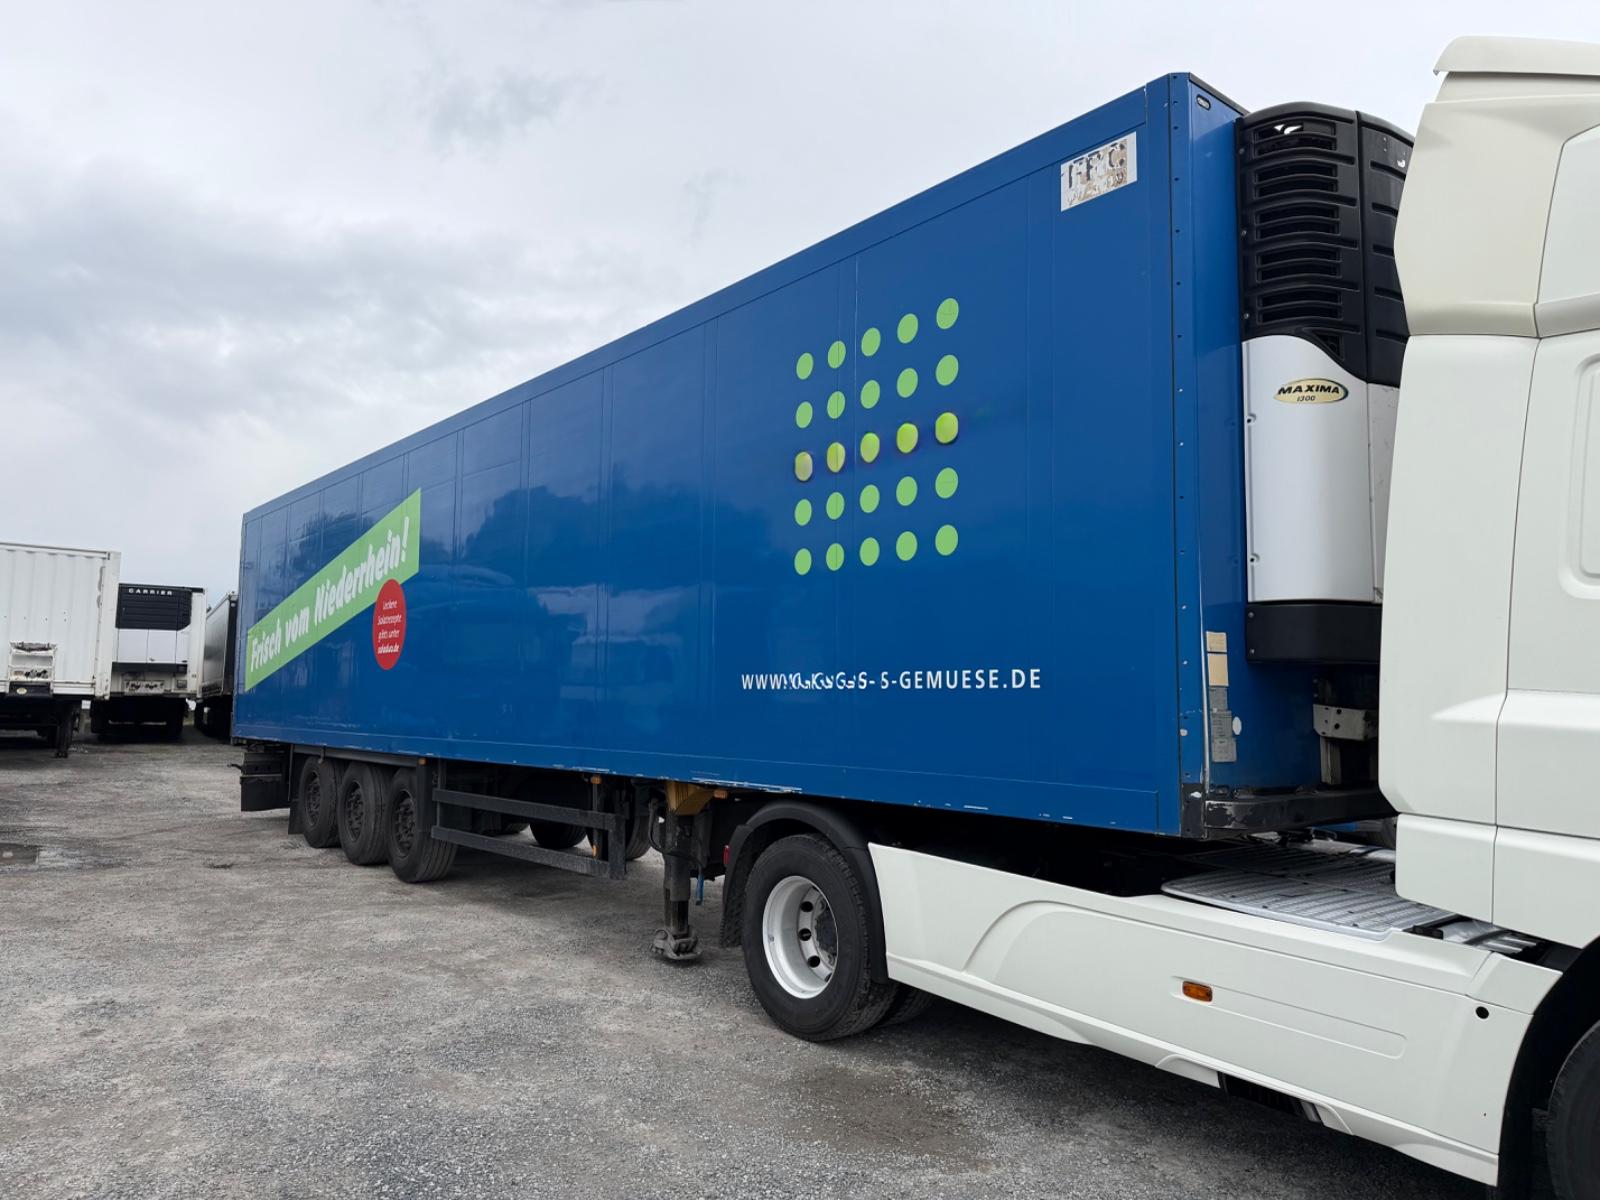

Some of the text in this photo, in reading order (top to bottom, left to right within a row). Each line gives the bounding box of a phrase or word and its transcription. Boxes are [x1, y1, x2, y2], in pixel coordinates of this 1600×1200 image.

[1278, 384, 1340, 395] MAXIMA
[128, 587, 173, 596] CARRIER
[250, 515, 410, 672] Frisch vom Niederrhein!
